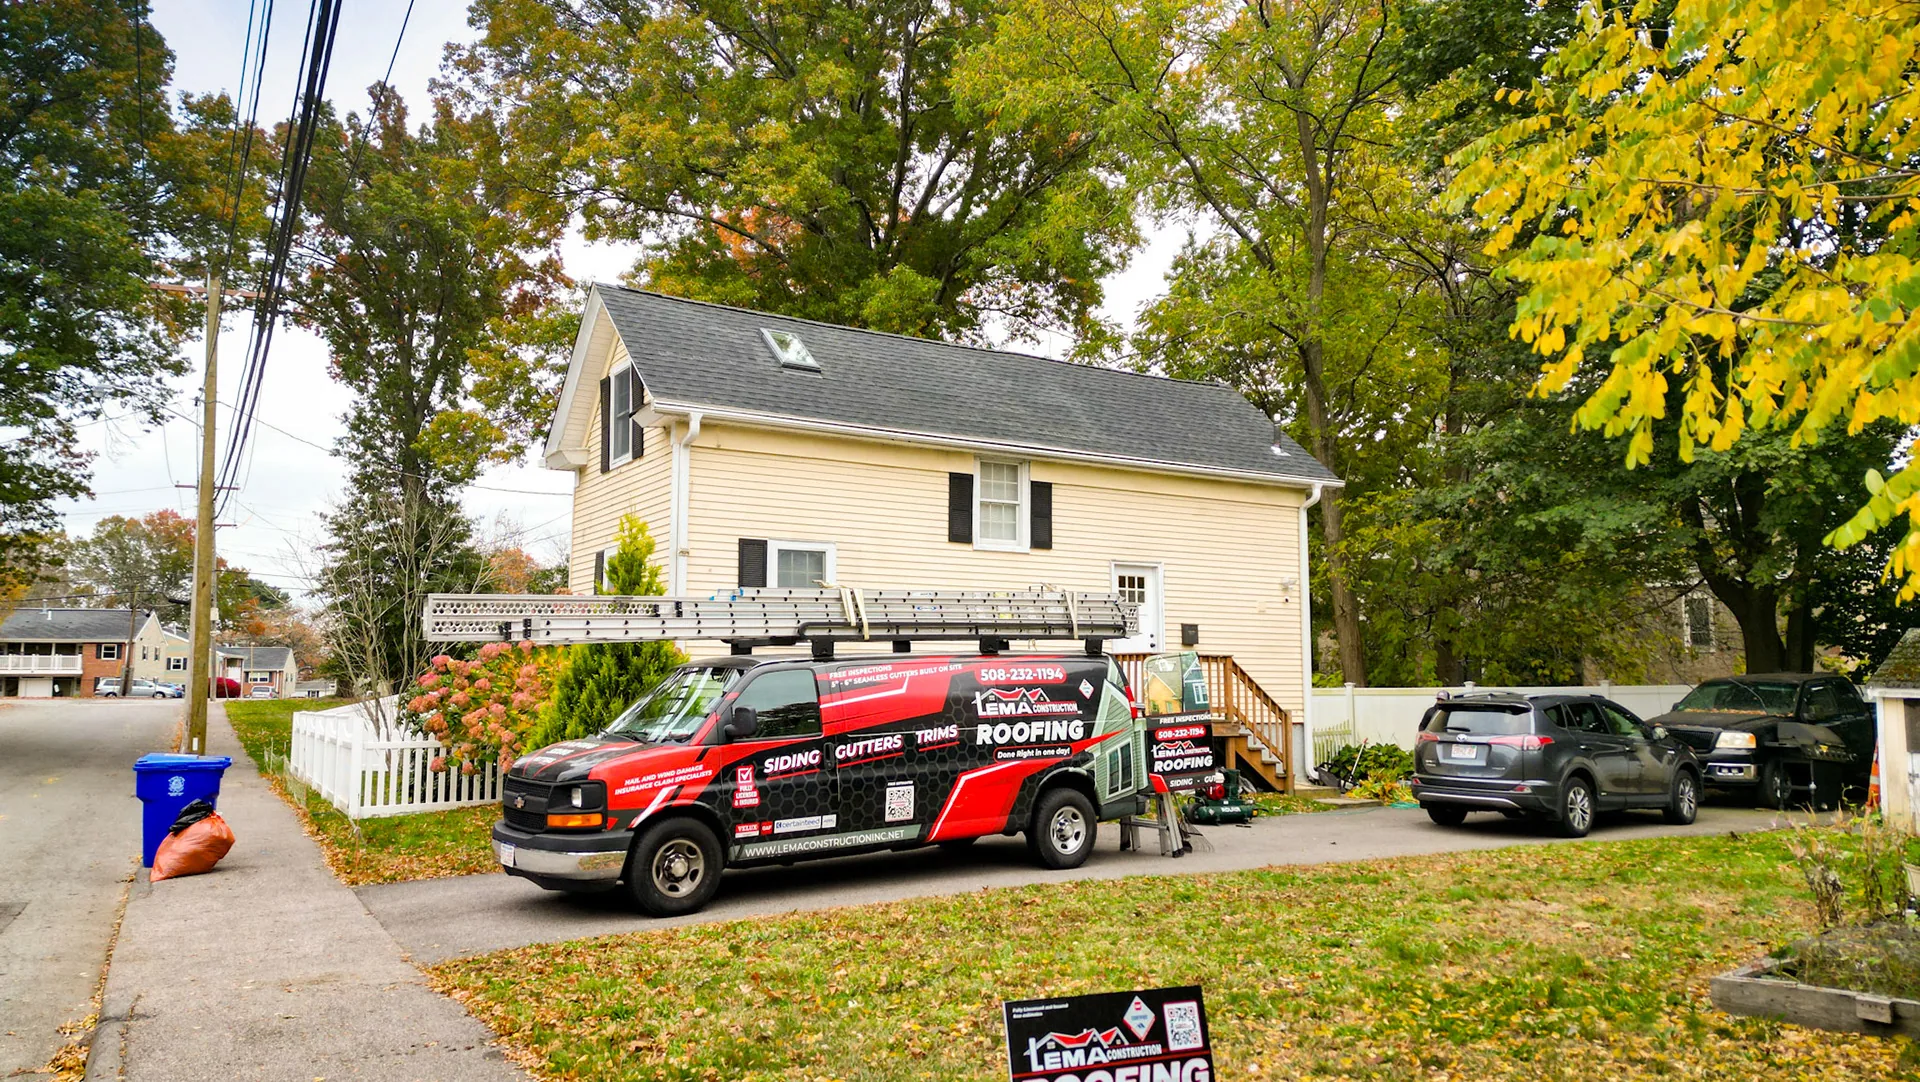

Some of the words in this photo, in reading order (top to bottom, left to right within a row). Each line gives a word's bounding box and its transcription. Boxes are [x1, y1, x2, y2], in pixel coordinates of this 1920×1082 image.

[830, 670, 846, 679] FREE
[848, 665, 892, 676] INSPECTIONS
[853, 674, 888, 684] SEAMLESS
[890, 670, 918, 679] GUTTERS
[919, 667, 937, 675] BUILT
[981, 668, 1063, 681] 508-232-1194
[975, 691, 1033, 716] LEMA
[1033, 703, 1078, 713] CONSTRUCTION
[915, 724, 959, 744] TRIMS
[976, 720, 1084, 745] ROOFING
[1158, 728, 1204, 738] 508-232-1194
[835, 735, 902, 759] GUTTERS
[1017, 749, 1034, 759] Right
[1056, 747, 1070, 756] day!
[1153, 745, 1185, 758] LEMA
[763, 750, 820, 773] SIDING
[1154, 755, 1213, 772] ROOFING
[657, 770, 675, 779] WIND
[676, 764, 703, 775] DAMAGE
[615, 781, 652, 795] INSURANCE
[654, 778, 674, 787] CLAIM
[675, 770, 712, 783] SPECIALISTS
[1170, 778, 1193, 787] SIDING
[745, 829, 904, 857] WWW.LEMACONSTRUCTIONINC.NET
[1029, 1037, 1109, 1072] LEMA
[1107, 1044, 1162, 1060] CONSTRUCTION
[1022, 1058, 1210, 1082] FING
